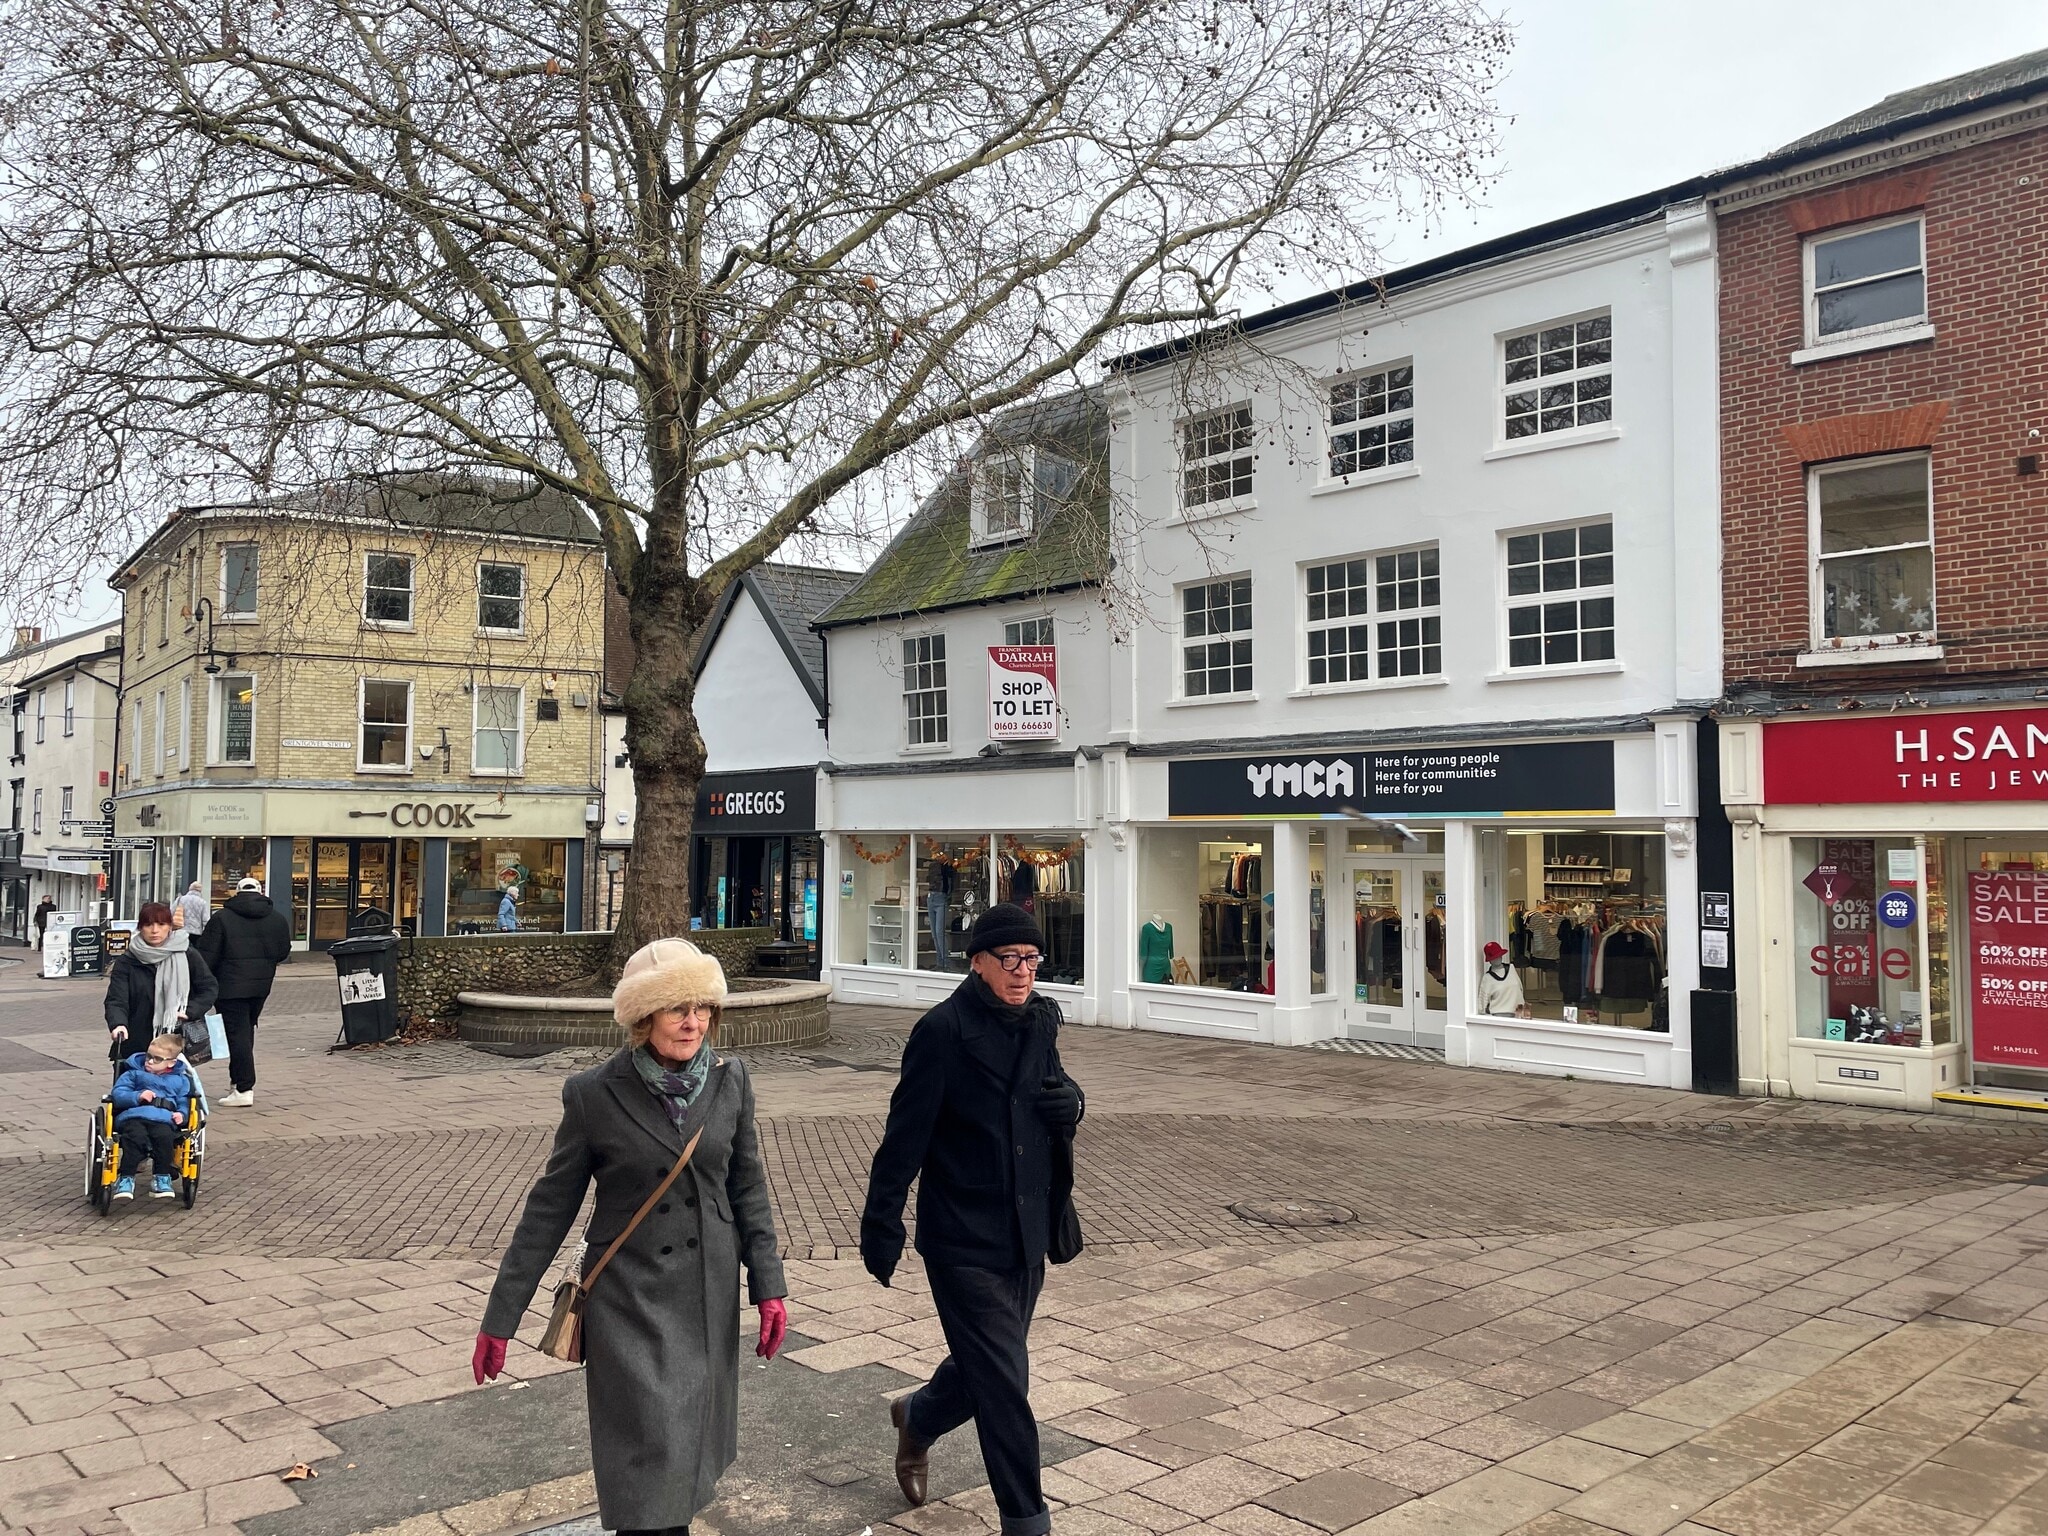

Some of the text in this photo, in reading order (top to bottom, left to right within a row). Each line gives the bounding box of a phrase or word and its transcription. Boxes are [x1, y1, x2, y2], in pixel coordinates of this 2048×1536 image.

[999, 652, 1053, 662] DARRAH
[1002, 682, 1042, 695] SHOP
[993, 700, 1053, 716] TO LET
[994, 721, 1052, 730] 01603 666630
[1375, 752, 1500, 769] Here for young people
[1247, 758, 1354, 798] YMCA
[1375, 767, 1497, 781] Here for communities
[1897, 772, 1961, 788] THE
[1375, 783, 1443, 796] Here for you
[725, 790, 785, 815] GREGGS
[391, 803, 476, 828] COOK
[1831, 862, 1871, 873] ALE
[1974, 884, 2048, 902] SALE
[1832, 899, 1870, 913] 60%
[1886, 900, 1908, 908] 20%
[1886, 907, 1908, 917] OFF
[1975, 905, 2048, 924] SALE
[1832, 913, 1870, 929] OFF
[1810, 932, 1911, 980] sale
[1980, 945, 2048, 959] 60% OFF
[1981, 957, 2048, 968] DIAMONDS
[1981, 977, 2048, 992] 50% OFF
[1982, 990, 2048, 1000] JEWELLERY
[1982, 997, 2048, 1009] & WATCHES
